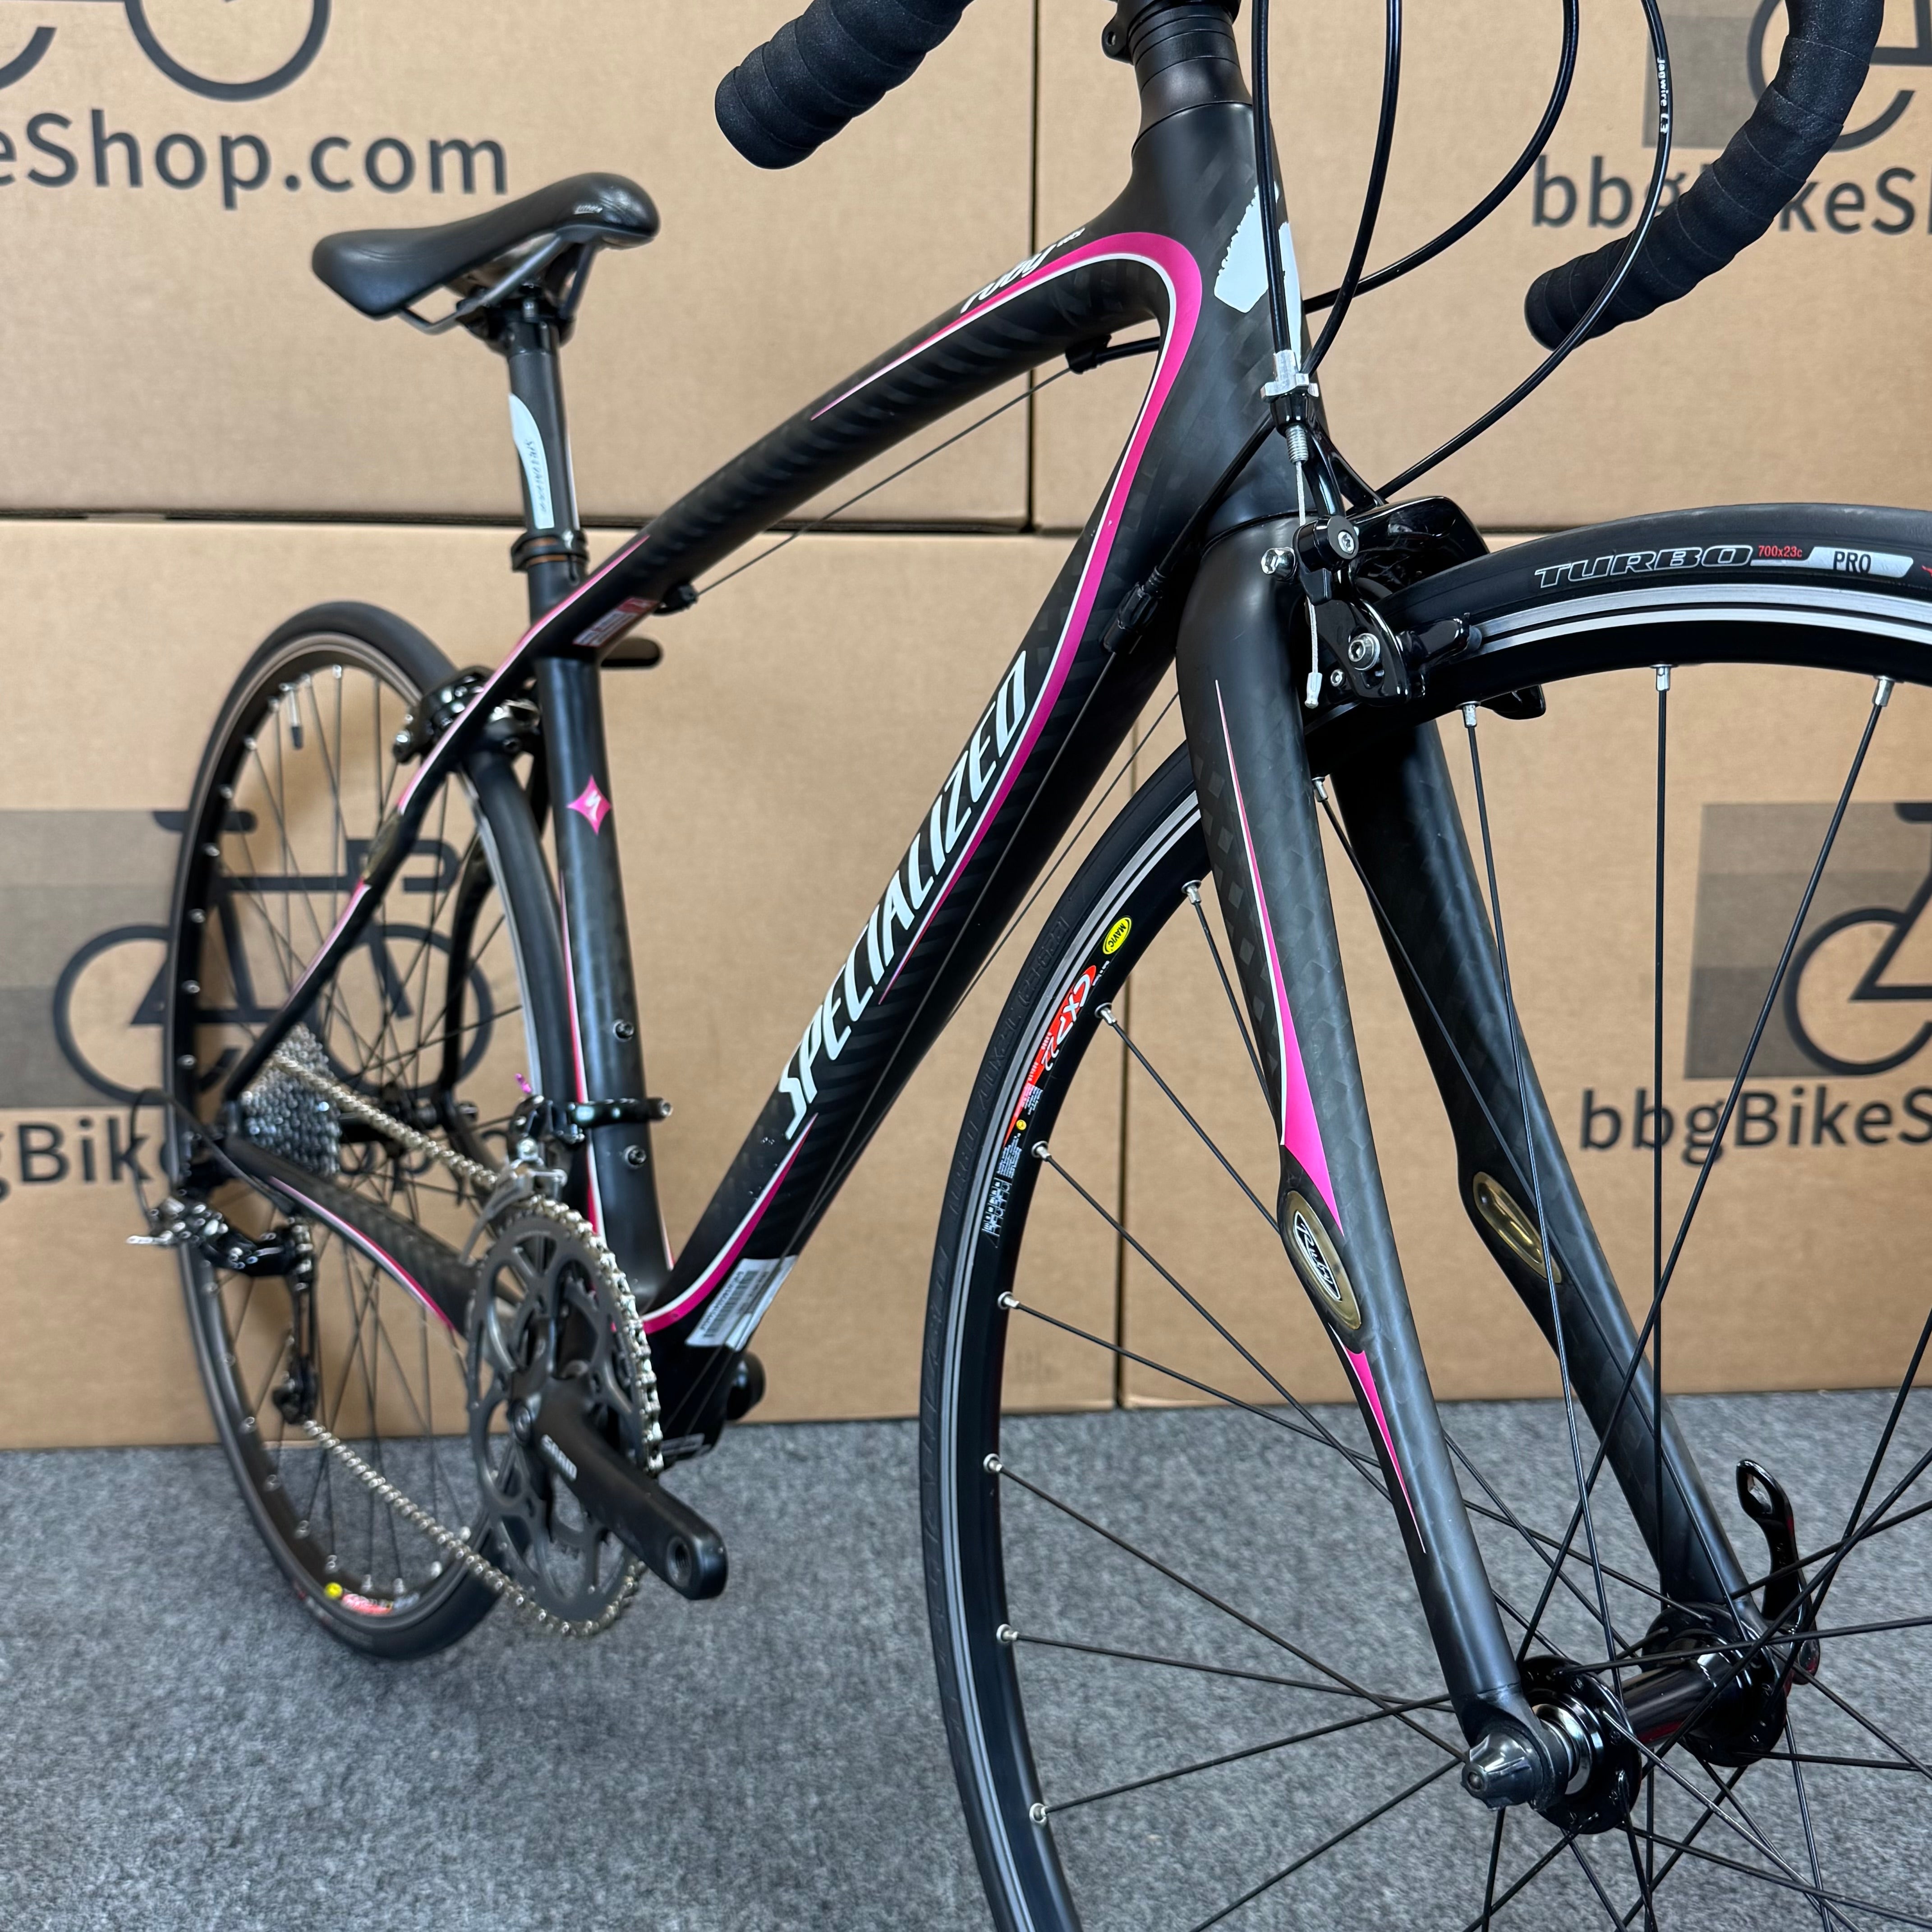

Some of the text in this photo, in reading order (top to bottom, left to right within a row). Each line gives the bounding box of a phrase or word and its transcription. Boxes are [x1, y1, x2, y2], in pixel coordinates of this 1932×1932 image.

[1534, 545, 1753, 589] TURBO
[1833, 551, 1872, 574] PRO
[778, 649, 1027, 1141] SPECIALIZED
[1108, 922, 1127, 948] MAVIC
